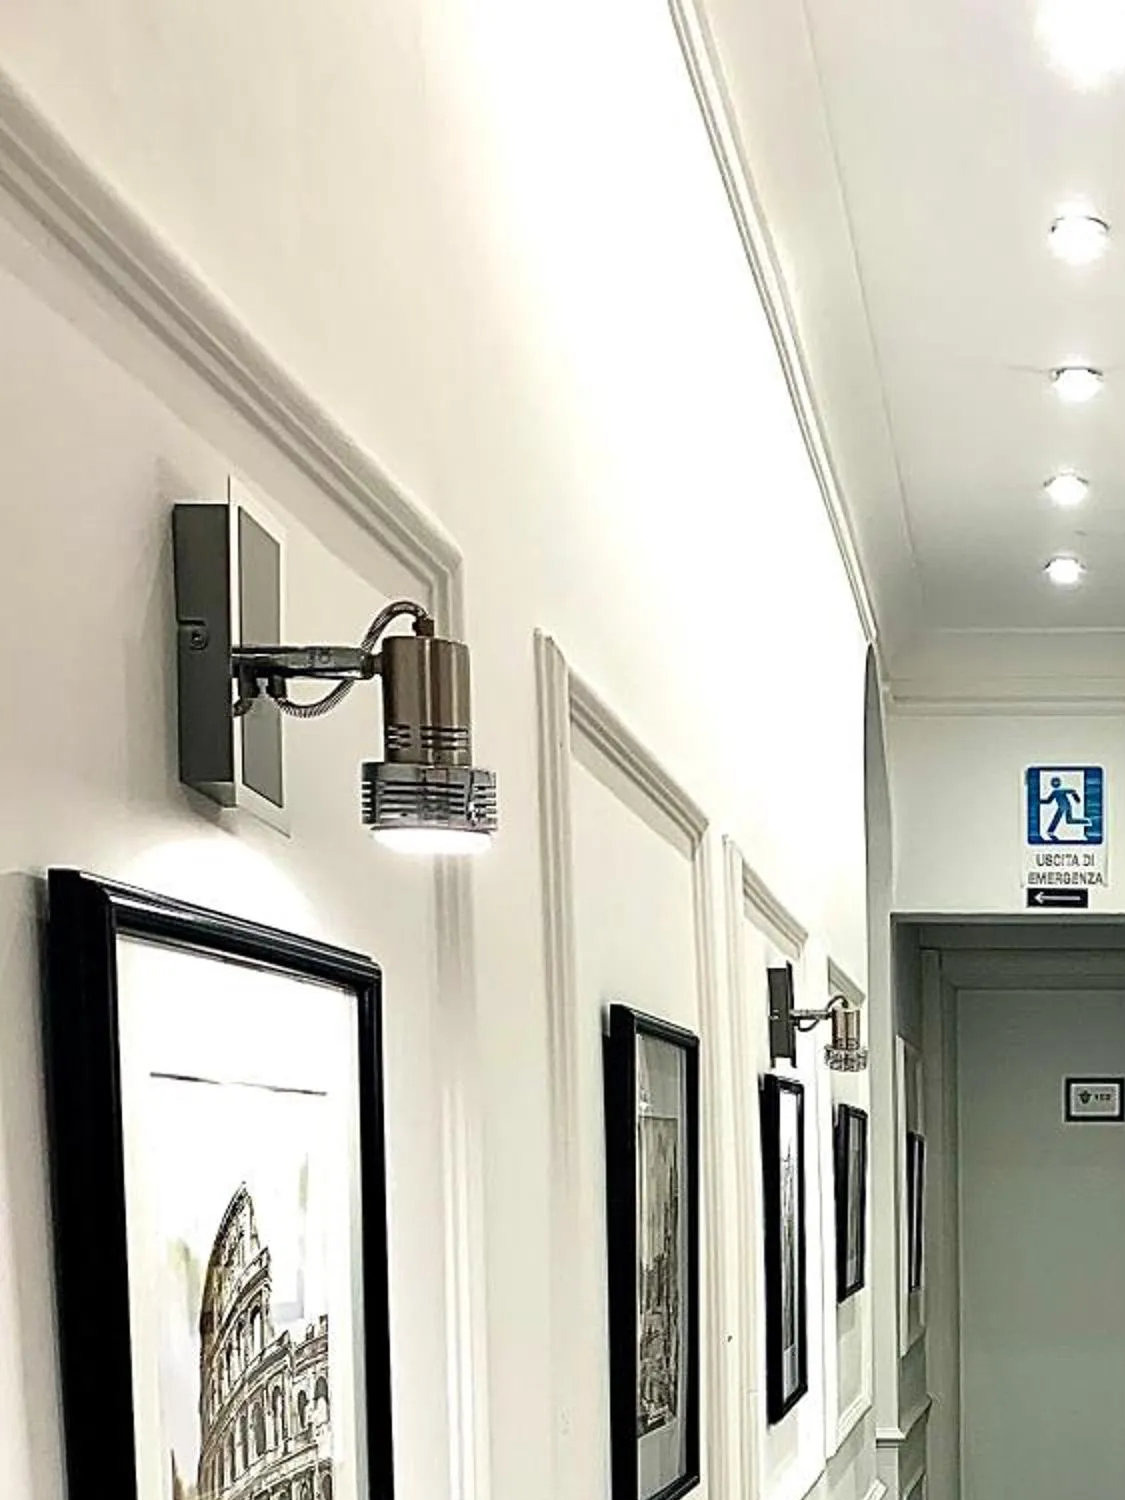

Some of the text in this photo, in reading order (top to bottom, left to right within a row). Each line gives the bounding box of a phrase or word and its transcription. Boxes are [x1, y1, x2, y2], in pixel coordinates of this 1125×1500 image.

[1036, 853, 1095, 867] USCITA DI
[1027, 871, 1103, 885] EMERGENZA
